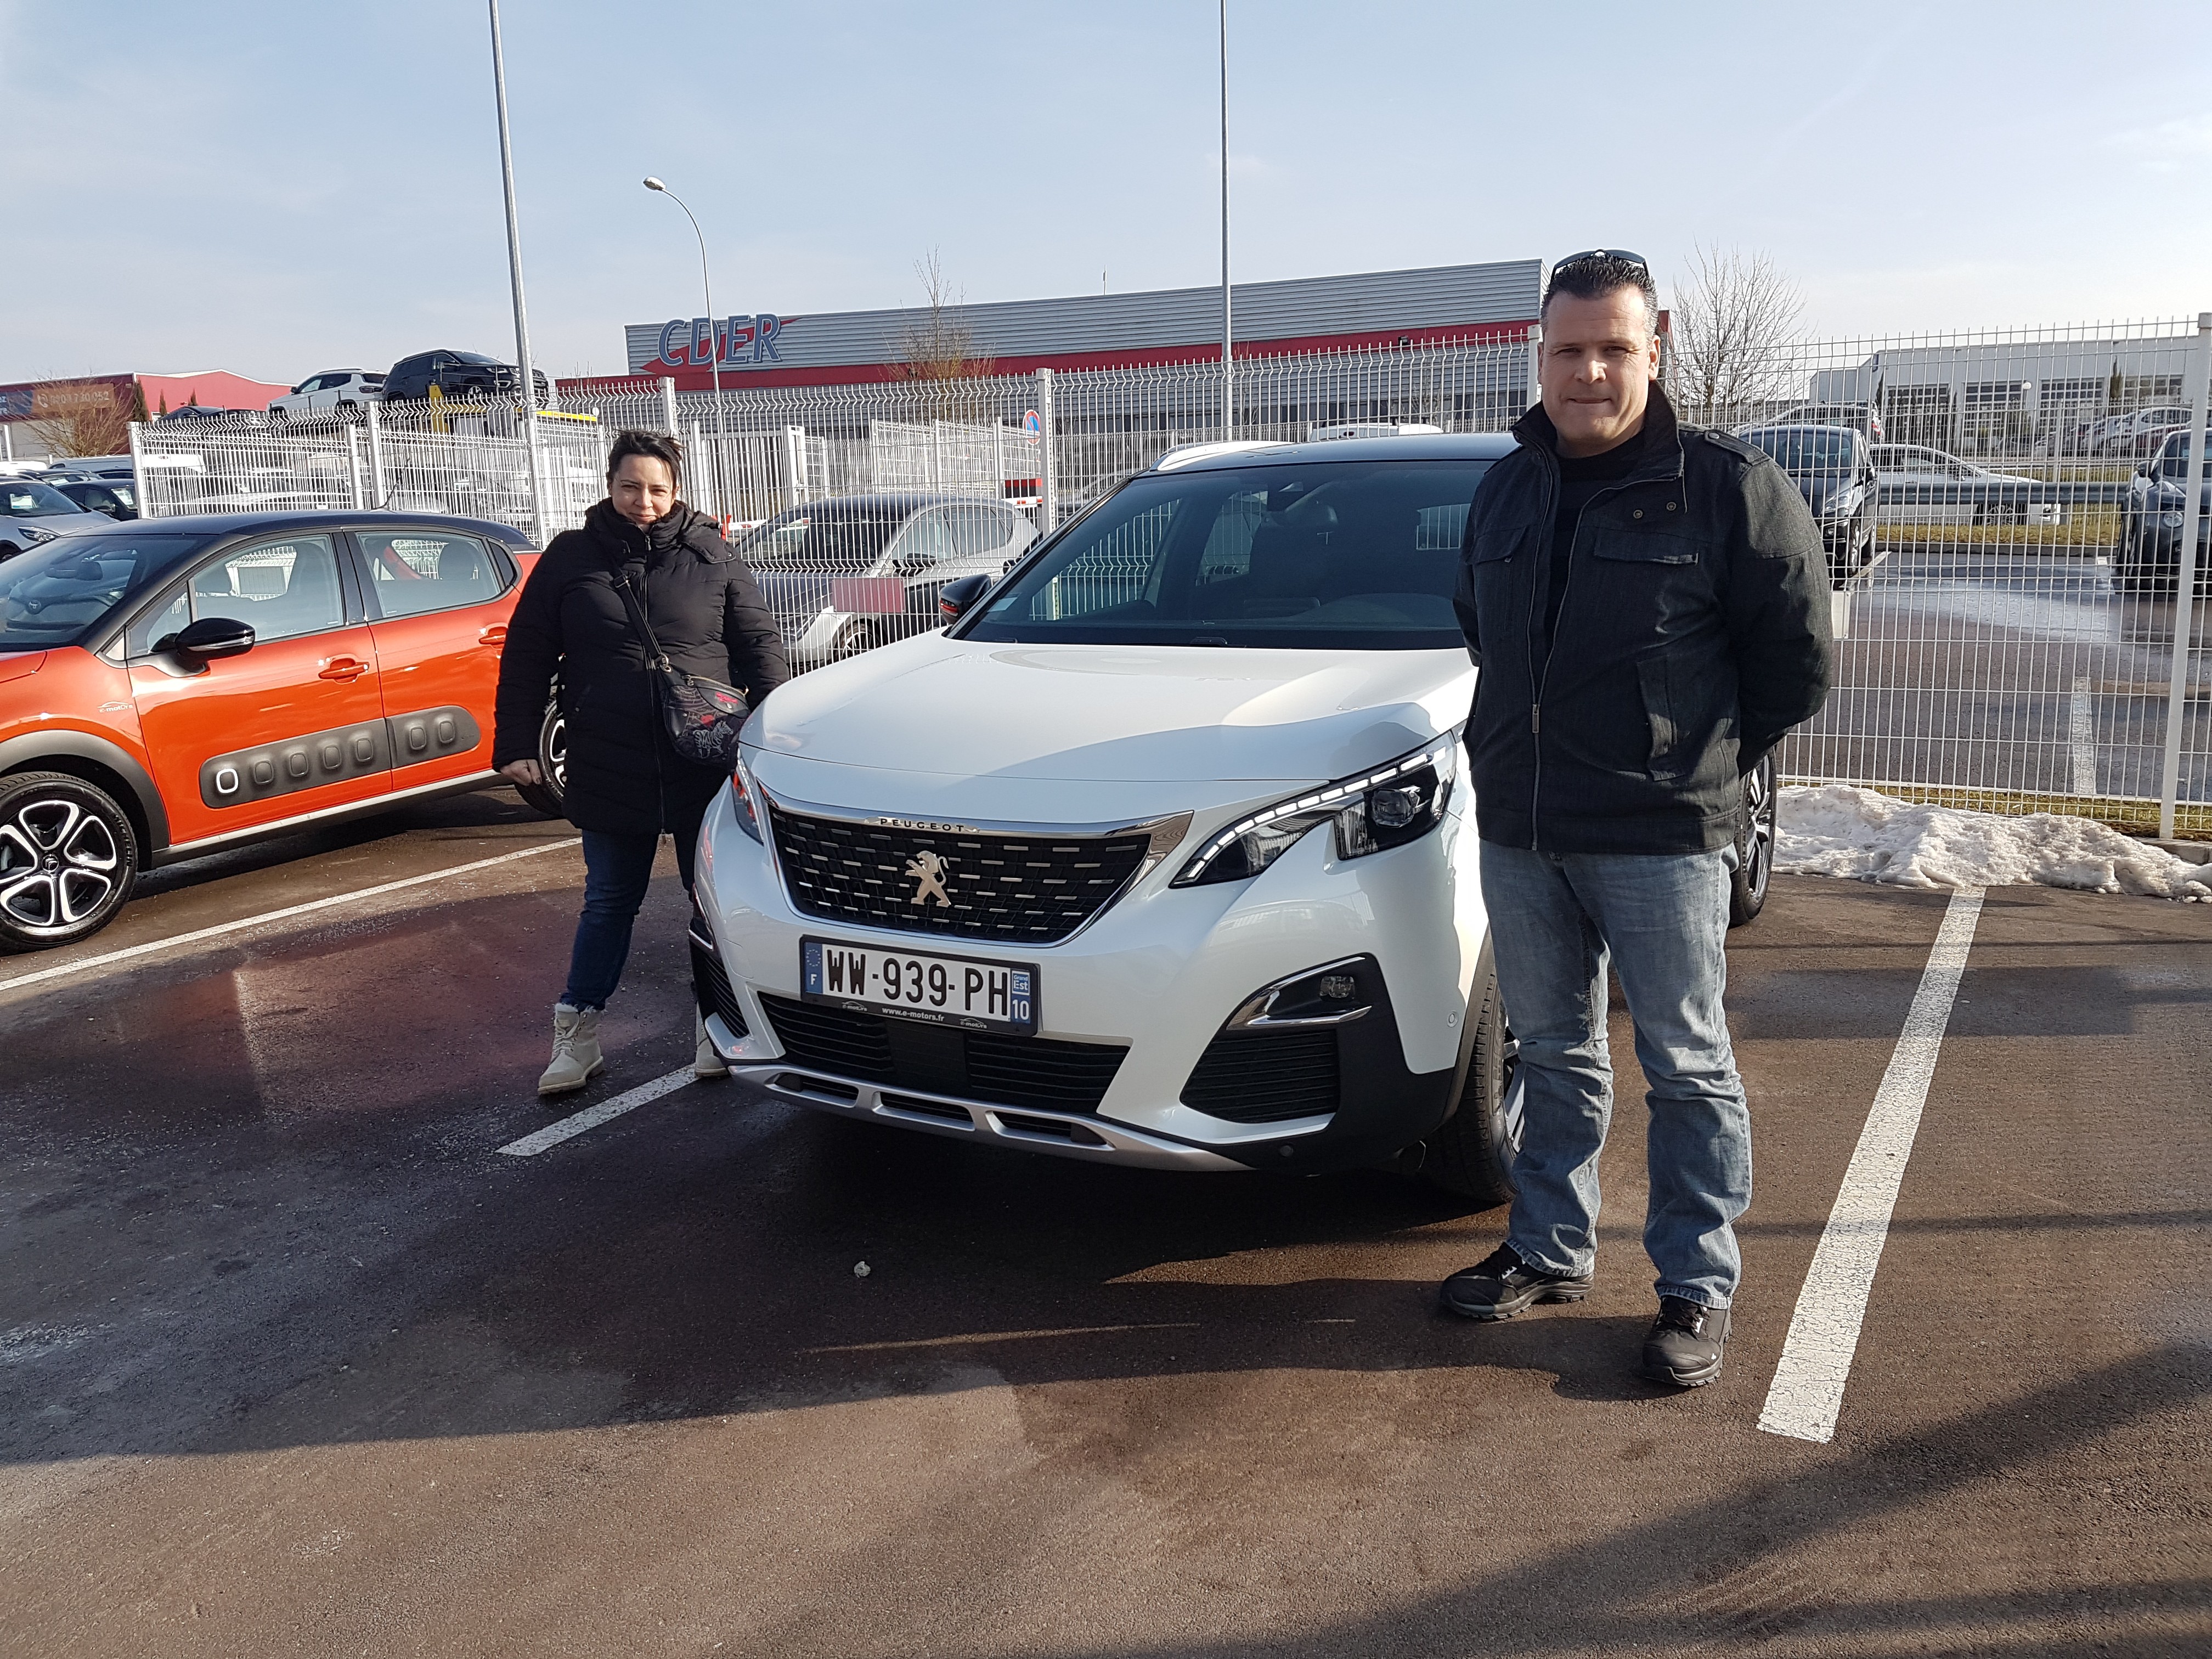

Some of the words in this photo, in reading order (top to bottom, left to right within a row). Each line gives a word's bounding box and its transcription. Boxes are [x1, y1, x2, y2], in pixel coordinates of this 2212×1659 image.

[657, 313, 783, 366] CDER
[880, 818, 964, 832] PEUGEOT
[809, 974, 817, 986] F
[1013, 980, 1028, 991] Est
[882, 1007, 945, 1022] www.e-motors.fr
[1012, 999, 1029, 1020] 10
